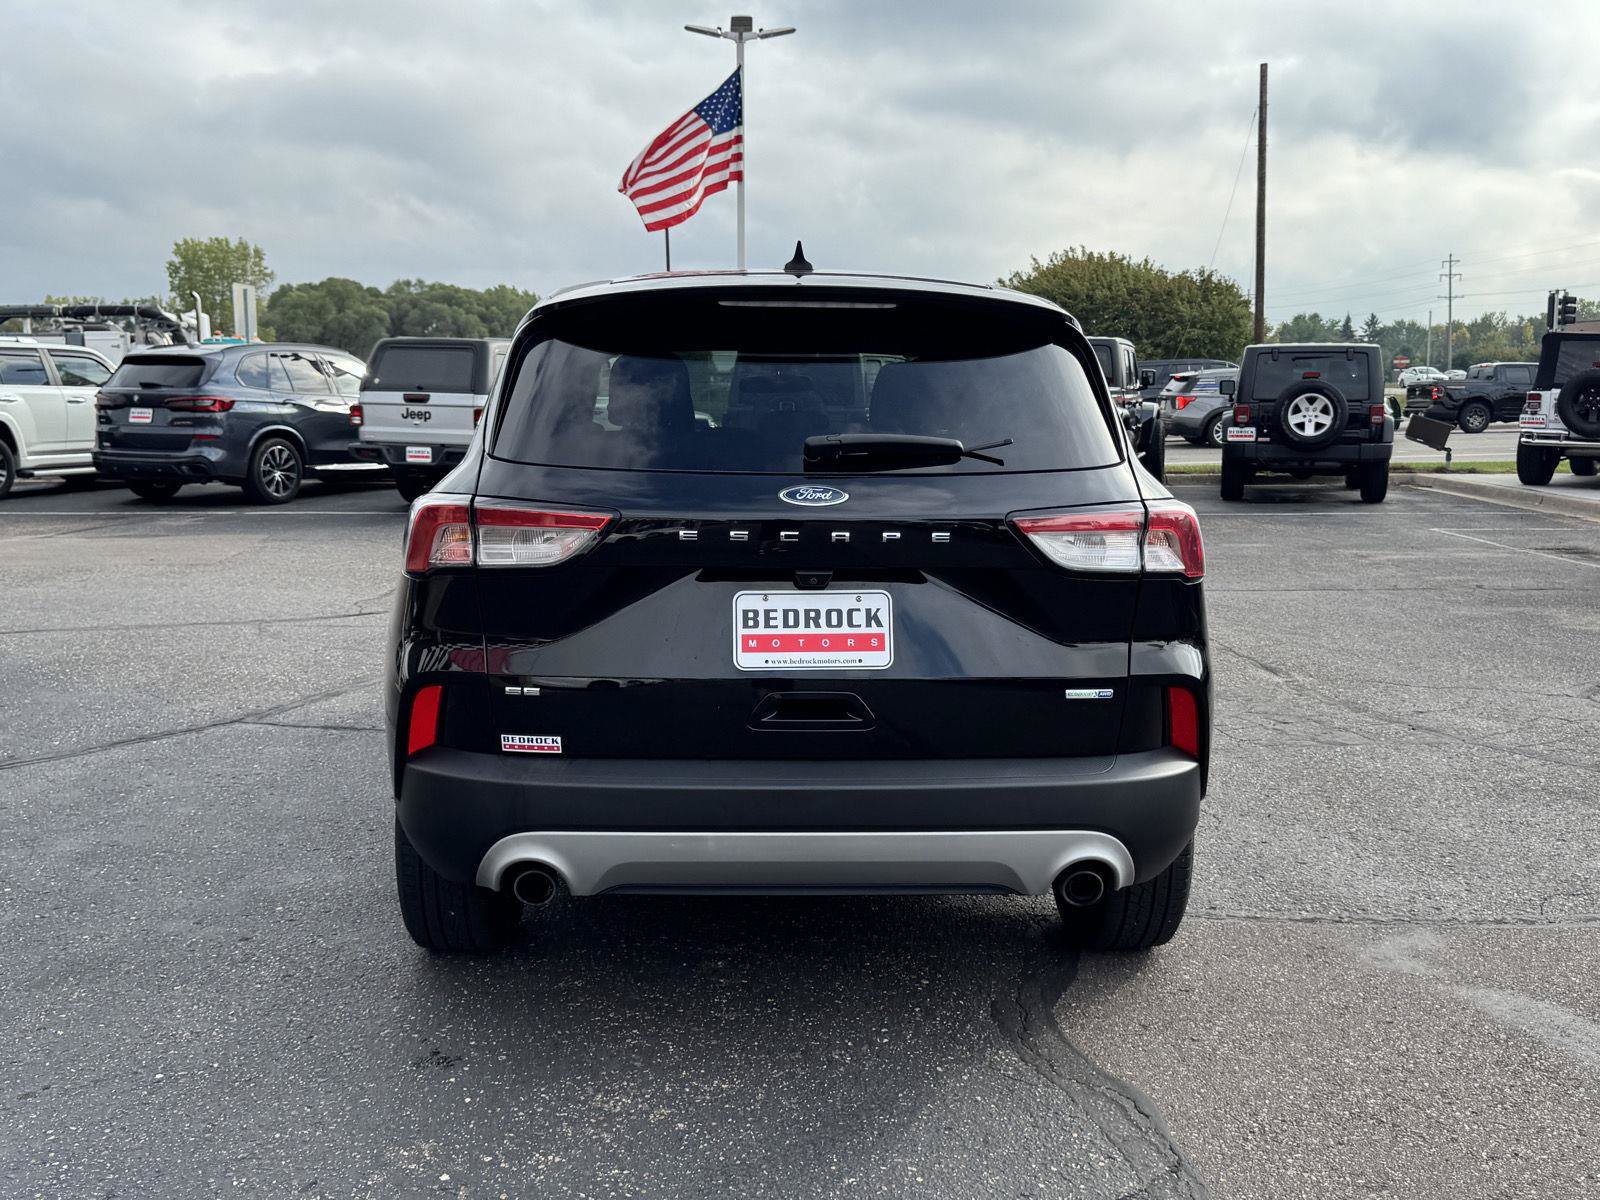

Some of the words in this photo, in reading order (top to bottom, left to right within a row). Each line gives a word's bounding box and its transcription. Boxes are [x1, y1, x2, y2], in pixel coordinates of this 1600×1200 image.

[401, 407, 432, 422] Jeep
[795, 488, 834, 501] Ford
[678, 530, 951, 543] ESCAPE
[741, 607, 885, 629] BEDROCK
[748, 638, 879, 648] MOTORS
[770, 657, 858, 666] www.bedrockmotors.com
[504, 686, 541, 696] SE
[502, 736, 560, 745] BEDROCK
